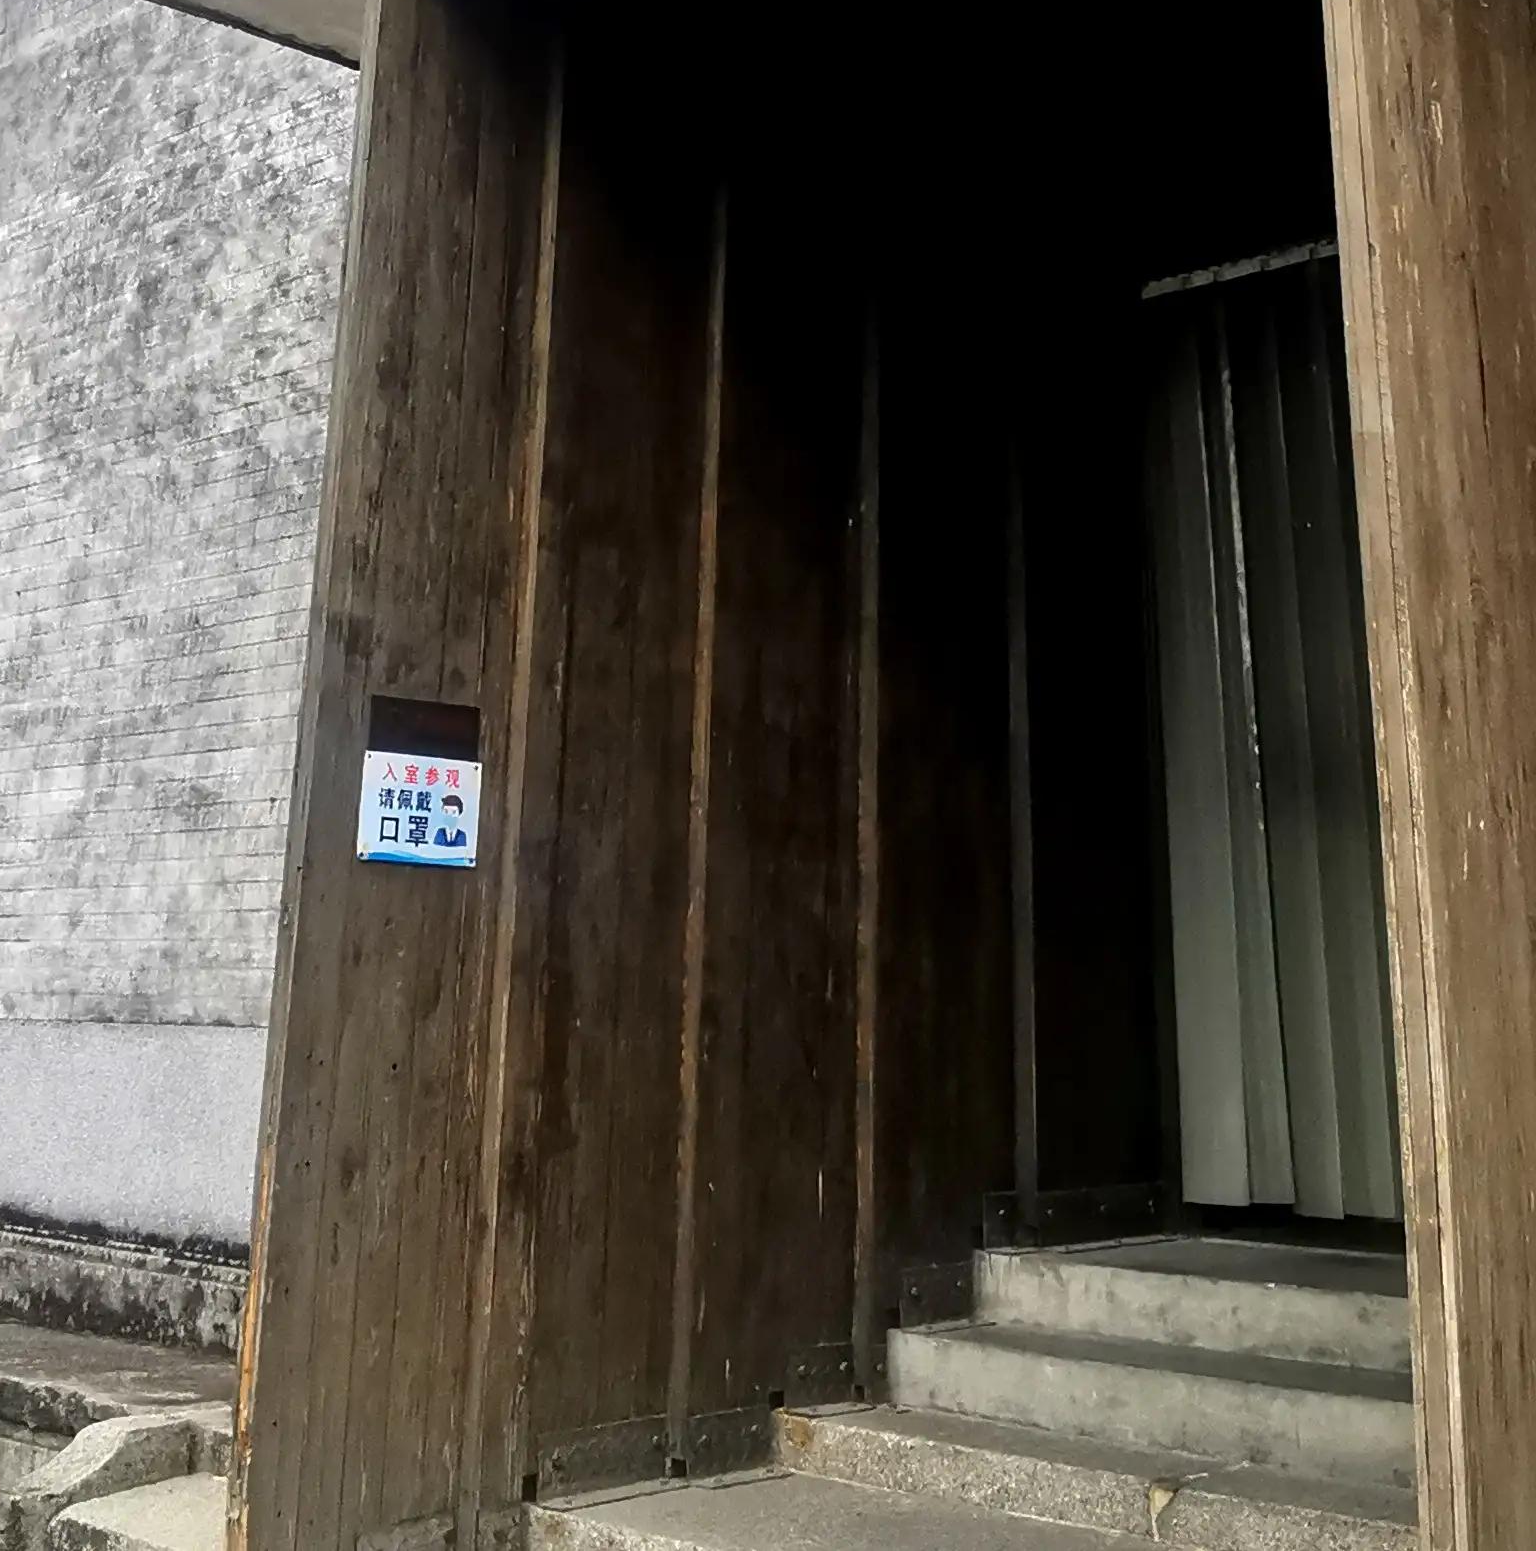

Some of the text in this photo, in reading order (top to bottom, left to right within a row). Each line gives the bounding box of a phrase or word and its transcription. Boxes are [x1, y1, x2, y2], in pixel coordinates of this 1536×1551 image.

[382, 762, 460, 788] 入室参观
[379, 788, 432, 812] 请佩戴
[380, 816, 429, 847] 口罩
